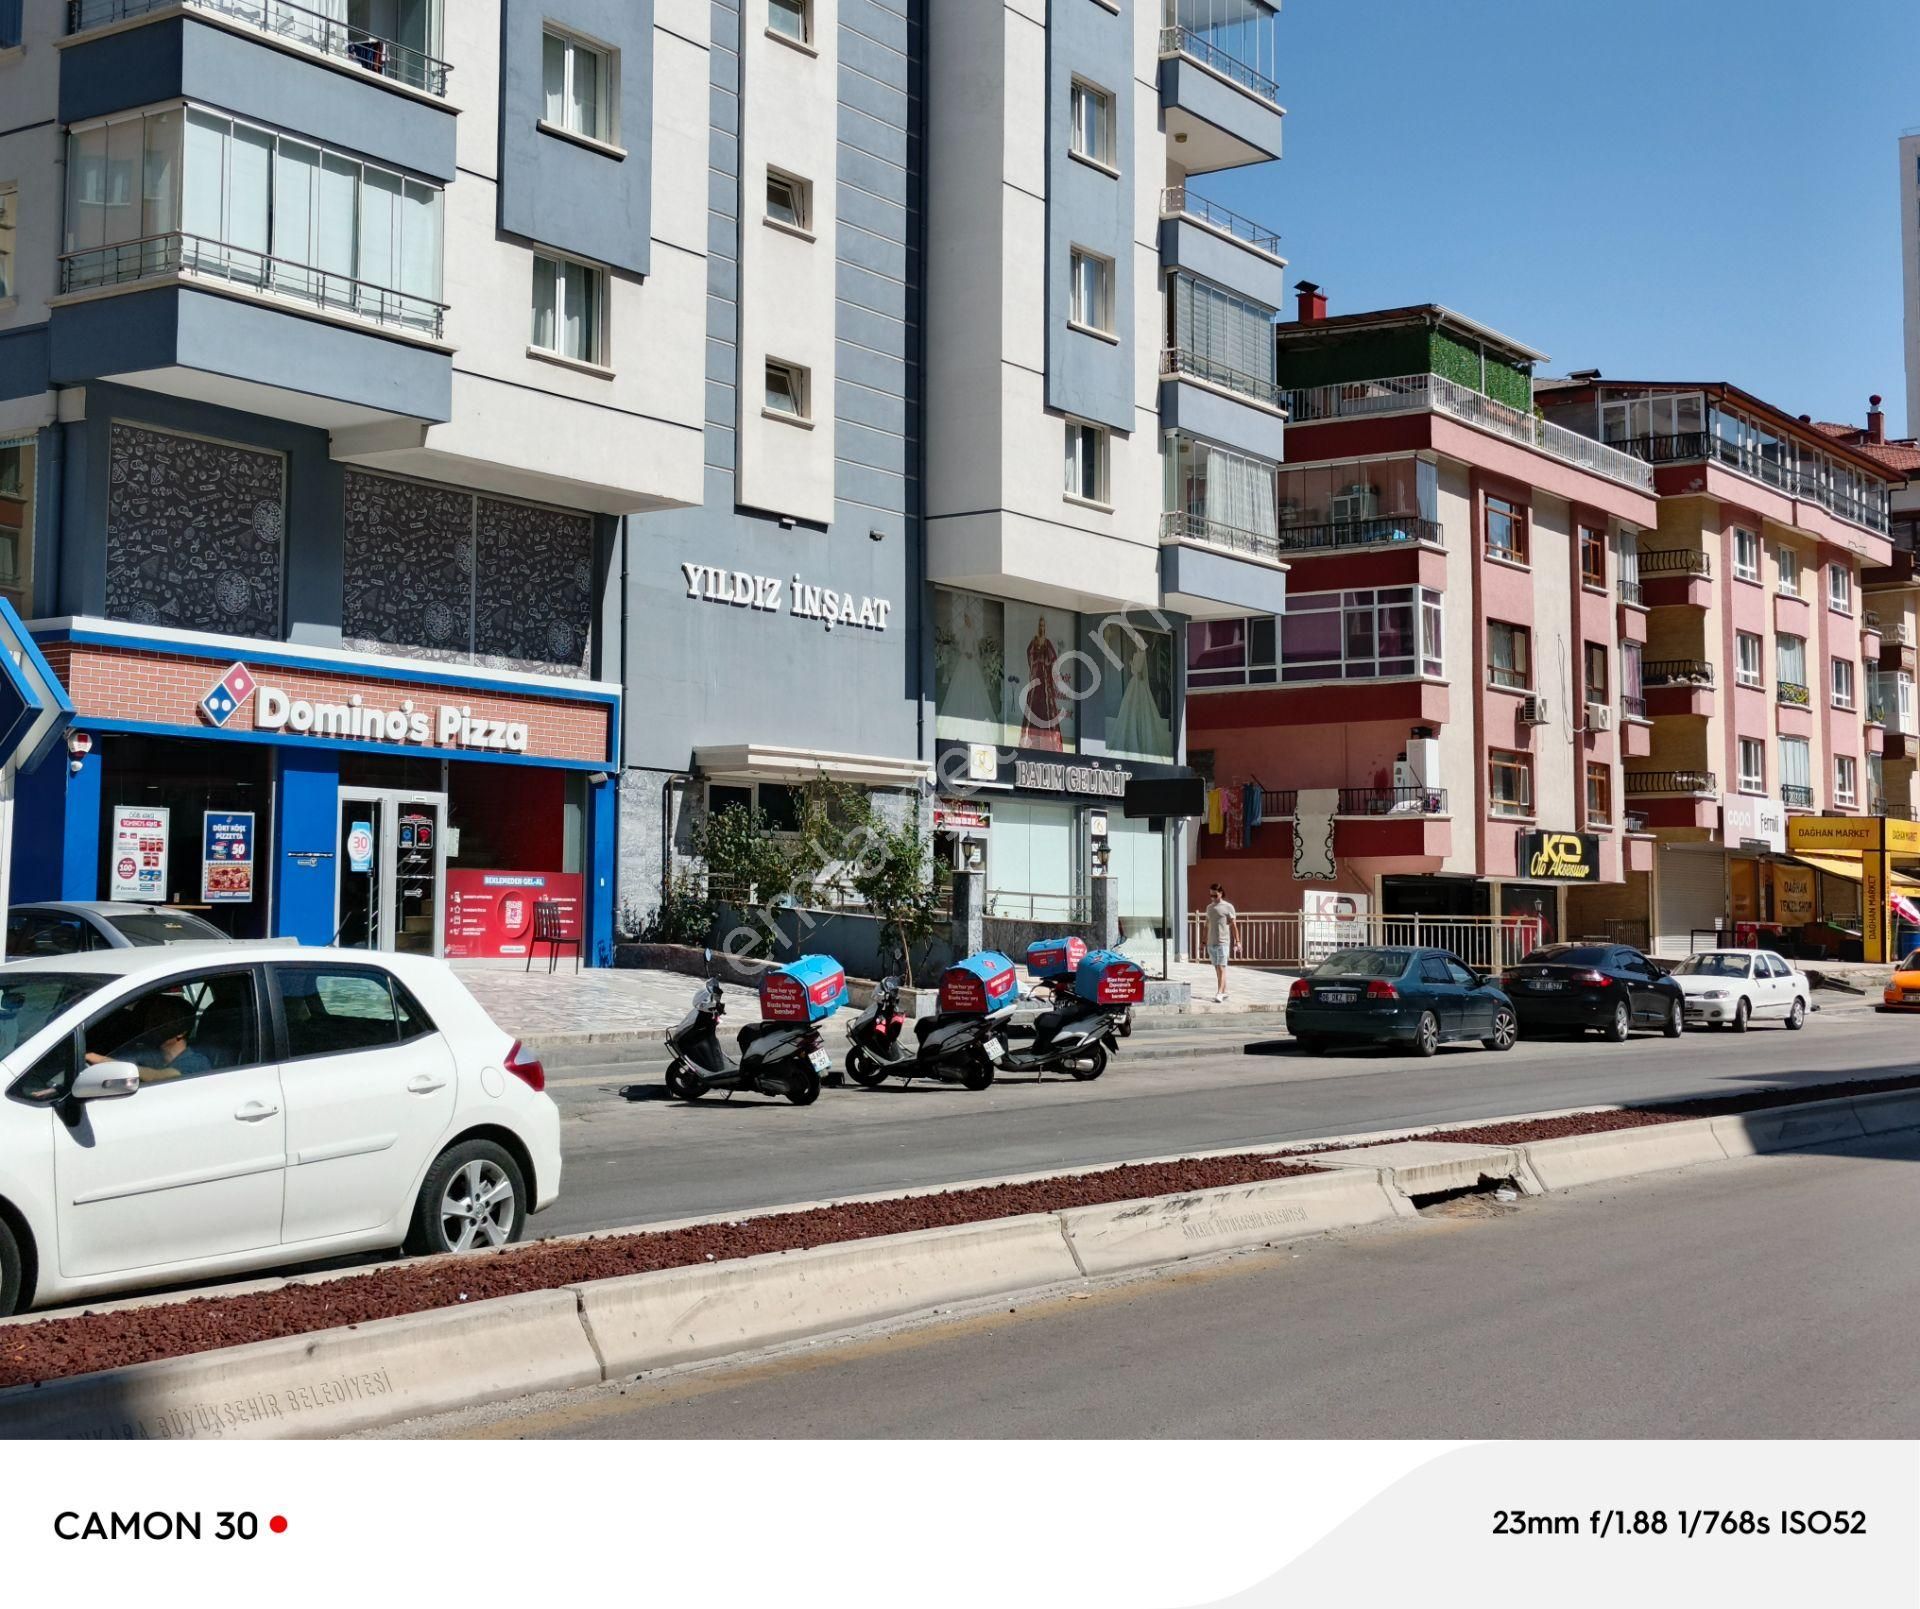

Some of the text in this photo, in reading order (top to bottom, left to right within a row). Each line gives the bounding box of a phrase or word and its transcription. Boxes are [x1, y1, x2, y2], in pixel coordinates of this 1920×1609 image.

[681, 562, 891, 631] YILDIZ İNŞAAT
[254, 686, 529, 751] Domino's Pizza
[1015, 761, 1132, 797] BALIM GELİNLİ
[1727, 809, 1750, 833] copa
[1798, 827, 1870, 838] DAĞHAN MARKET
[232, 843, 246, 855] 50
[353, 836, 368, 848] 30
[1543, 833, 1582, 862] KD
[1530, 852, 1590, 878] Oto Aksesuar
[1784, 879, 1808, 894] DAĞHAN
[1867, 875, 1876, 940] DAĞHAN MARKET
[156, 1391, 283, 1439] BÜYÜKŞEHİR
[286, 1366, 393, 1412] BELEDİYESİ
